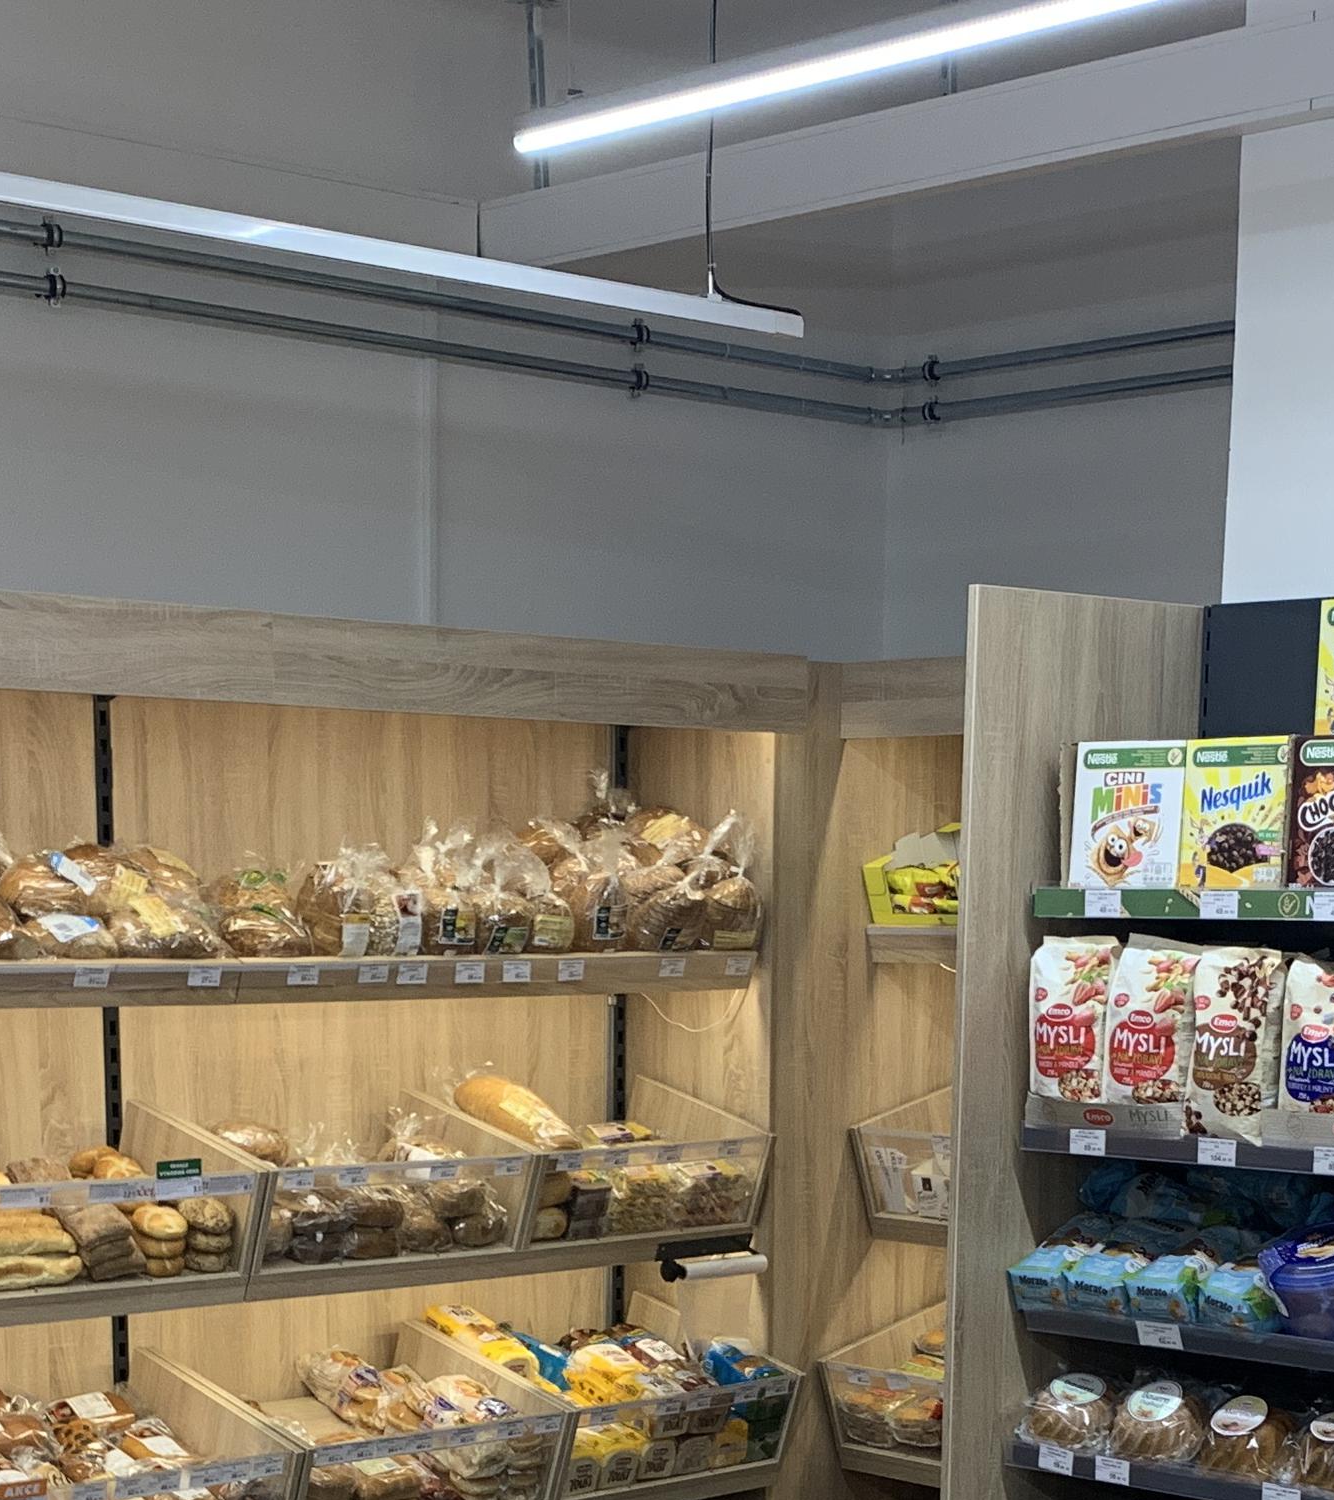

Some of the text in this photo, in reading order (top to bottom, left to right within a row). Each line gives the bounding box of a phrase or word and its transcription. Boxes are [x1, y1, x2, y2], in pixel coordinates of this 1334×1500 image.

[1105, 771, 1144, 788] CINI
[1200, 771, 1273, 813] Nesquik
[1035, 1021, 1085, 1048] MYSLI
[1113, 1029, 1166, 1061] MYSLI
[1195, 1031, 1246, 1062] MYSLI
[1084, 1111, 1112, 1124] Emco
